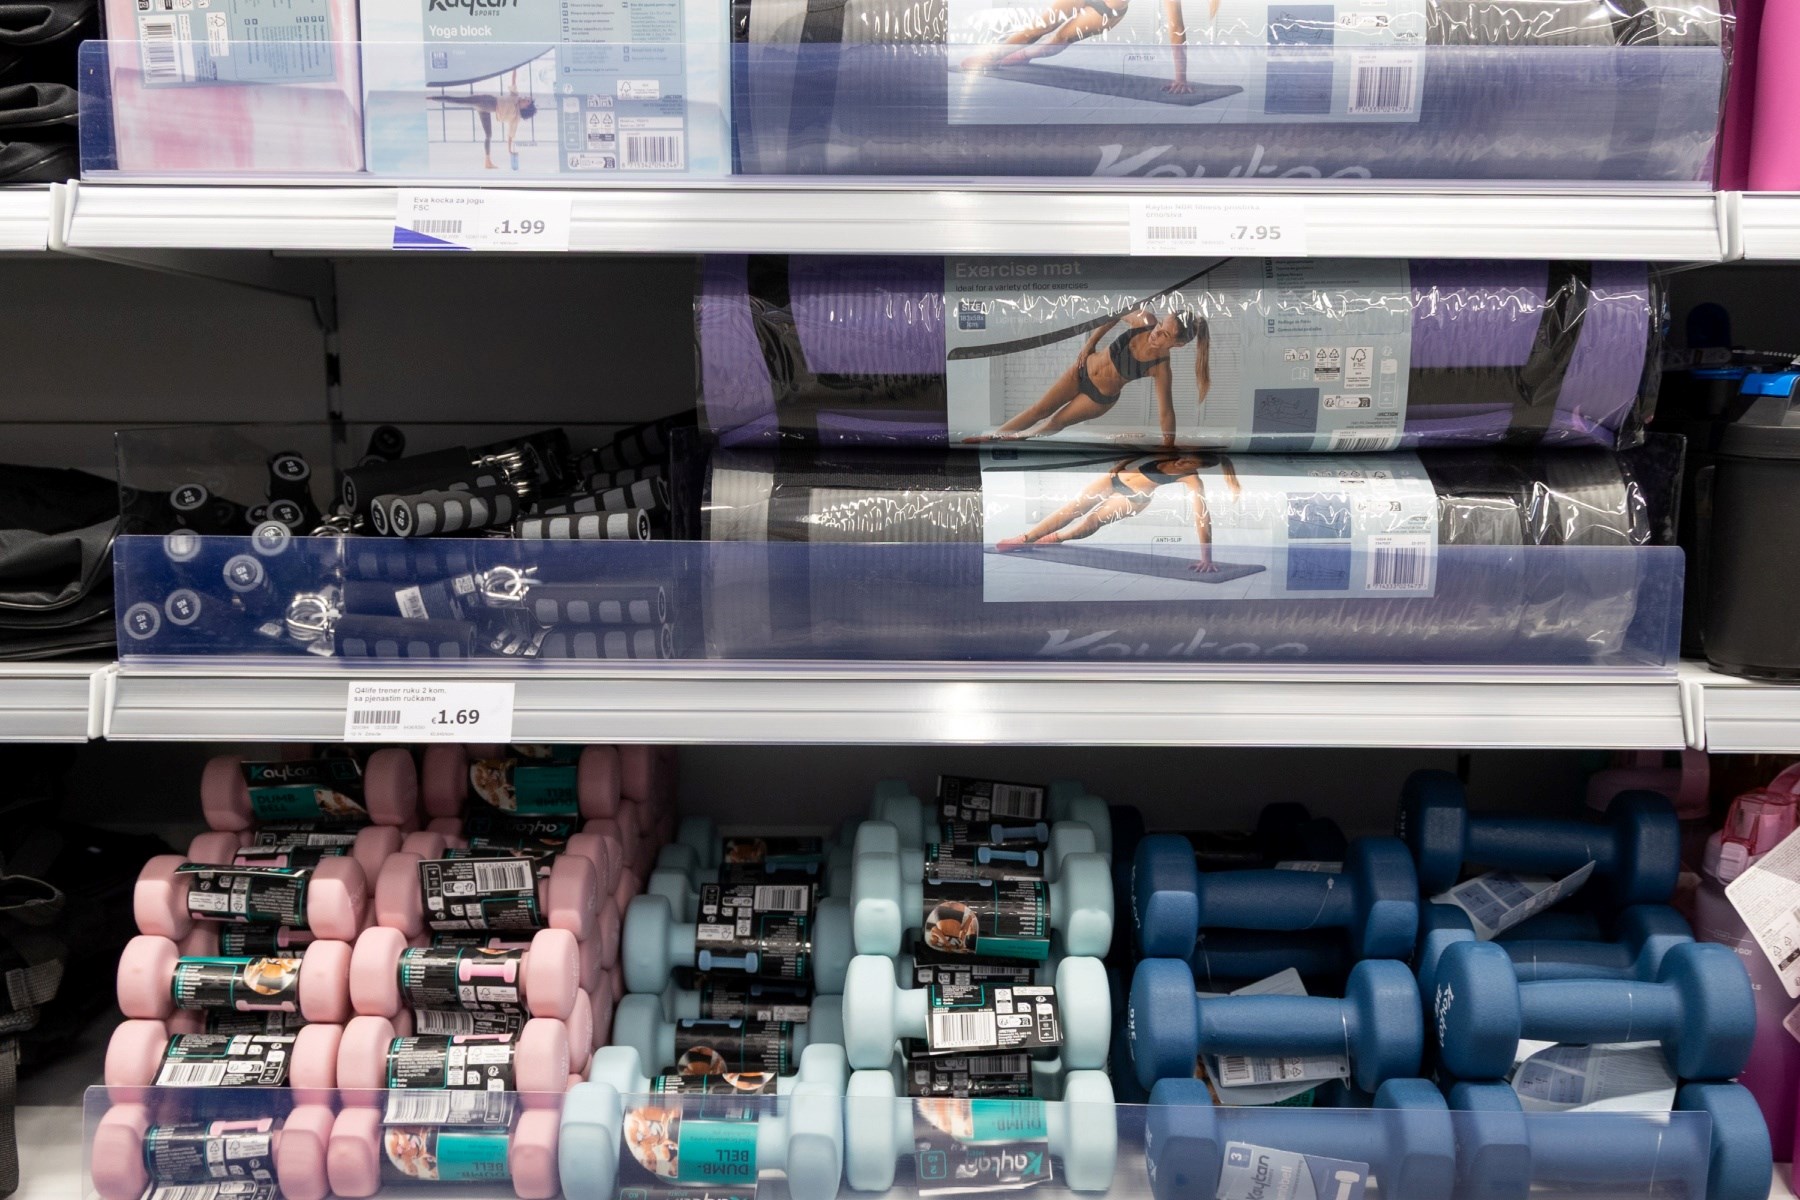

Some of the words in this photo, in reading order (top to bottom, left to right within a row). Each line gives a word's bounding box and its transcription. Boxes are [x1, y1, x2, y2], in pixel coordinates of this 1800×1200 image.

[429, 25, 457, 38] Yoga
[460, 25, 492, 36] block
[413, 196, 429, 204] Eva
[431, 196, 454, 204] kocka
[466, 197, 485, 206] jogu
[955, 261, 1038, 279] Exercise
[1043, 261, 1082, 277] mat
[955, 284, 974, 292] Ideal
[975, 283, 988, 291] for
[994, 283, 1021, 293] variety
[1022, 282, 1032, 290] of
[1033, 282, 1050, 290] floor
[1051, 281, 1089, 290] exercises
[961, 303, 981, 311] SIZE
[365, 694, 401, 704] pjenastim
[403, 694, 437, 702] ručkama
[250, 765, 318, 781] Kaytan
[716, 1150, 750, 1162] BELL
[1230, 1152, 1243, 1161] 3
[471, 1161, 504, 1171] BELL
[697, 1163, 750, 1176] DUMB-
[930, 1165, 937, 1174] 2
[964, 1149, 1043, 1178] Kaytan
